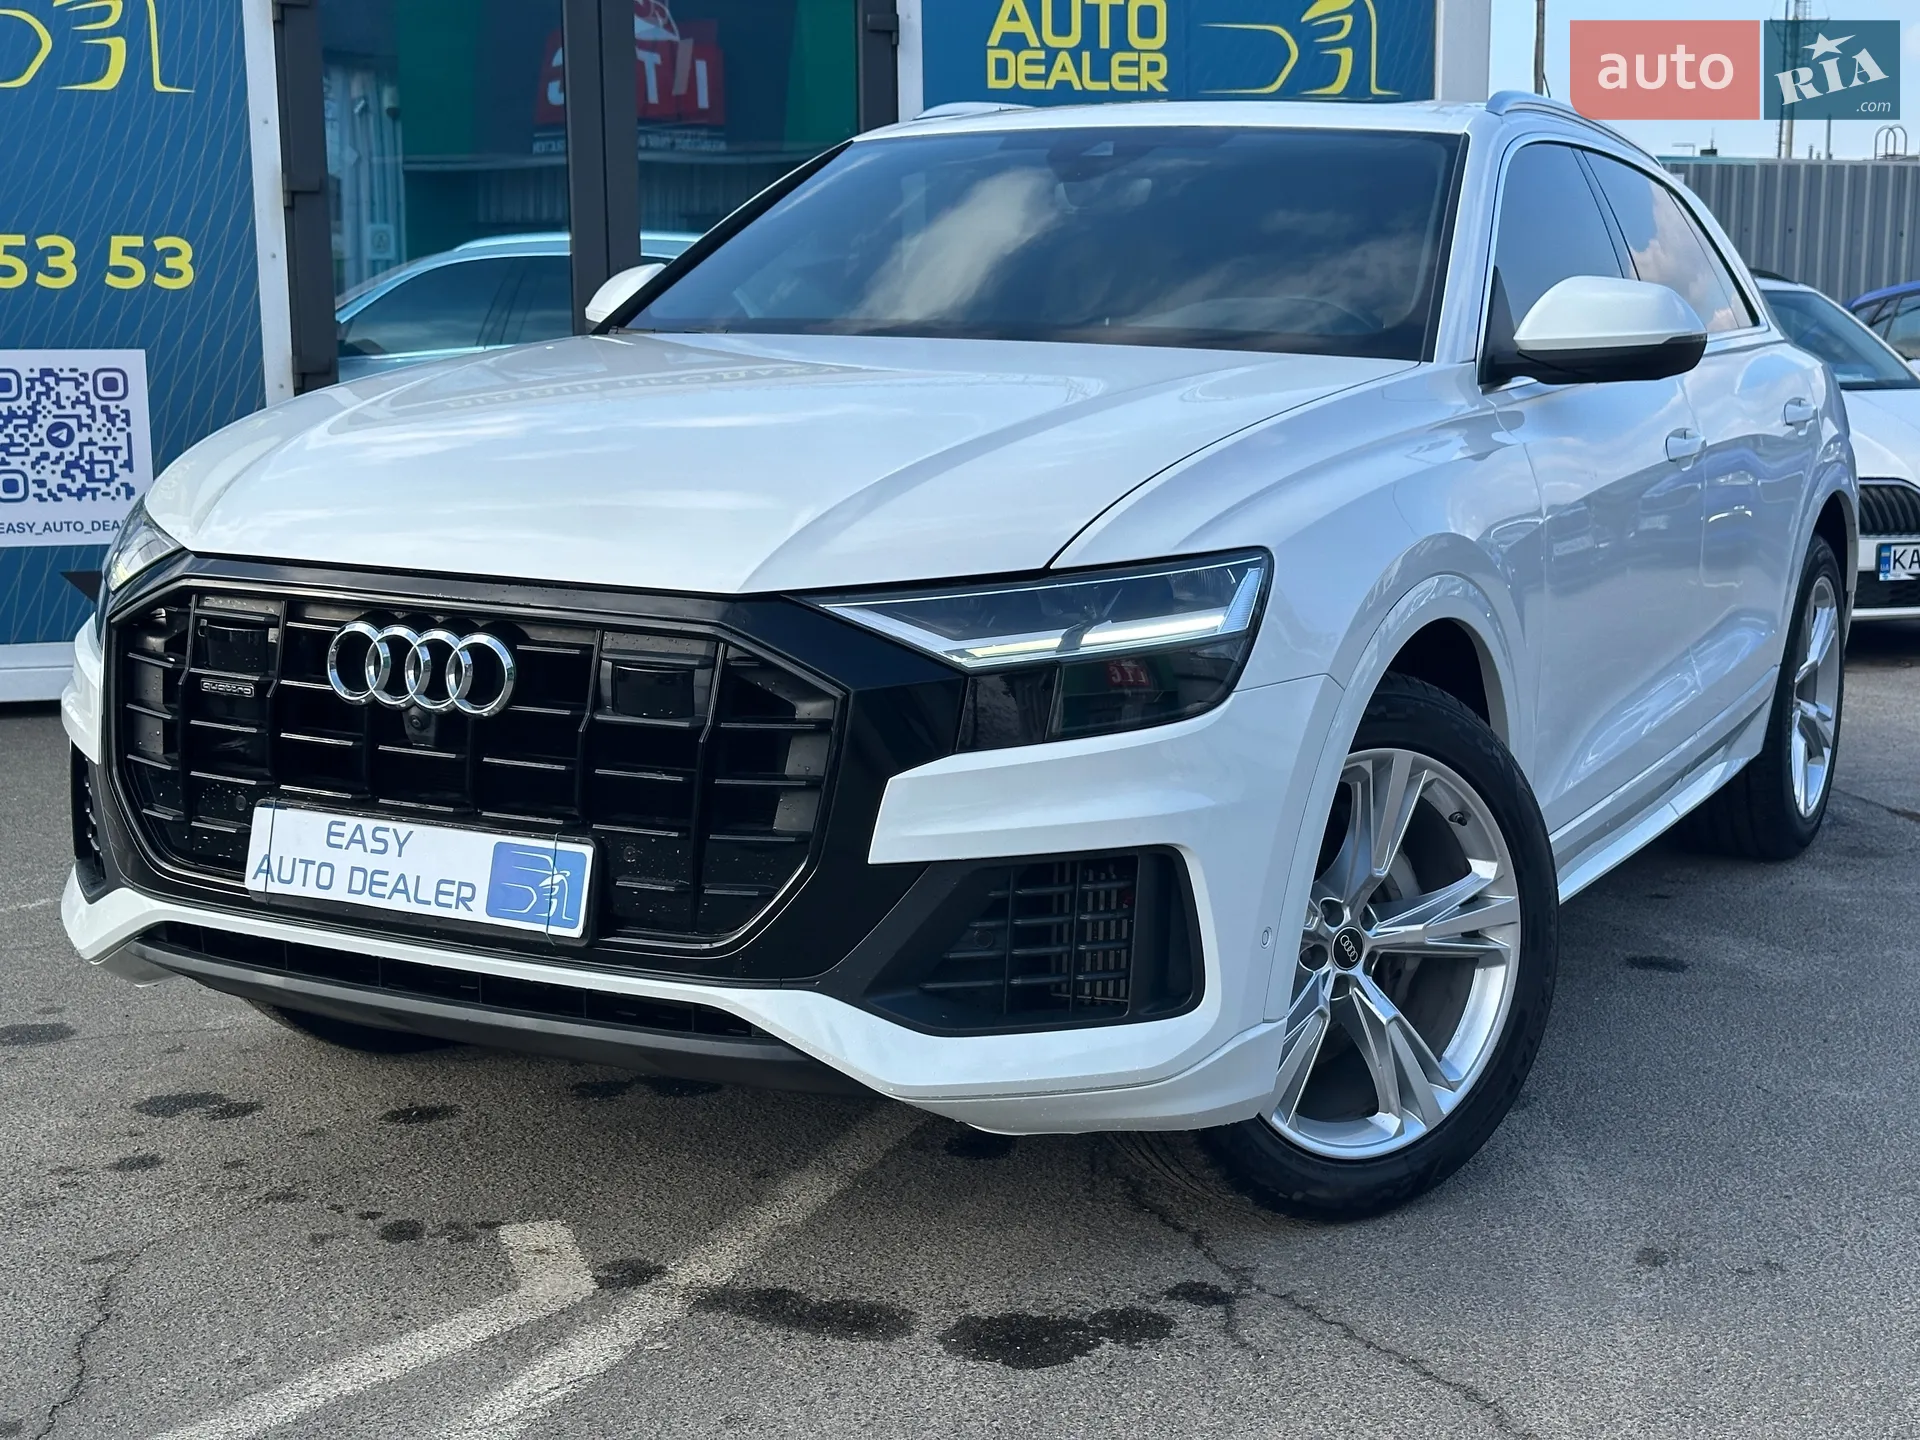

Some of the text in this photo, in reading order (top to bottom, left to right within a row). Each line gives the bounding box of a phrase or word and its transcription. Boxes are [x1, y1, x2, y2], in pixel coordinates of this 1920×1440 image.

[987, 0, 1167, 50] AUTO
[987, 49, 1169, 92] DEALER
[0, 234, 195, 290] 53 53
[1892, 549, 1920, 570] KA
[325, 819, 414, 858] EASY
[252, 853, 477, 913] AUTO DEALER
